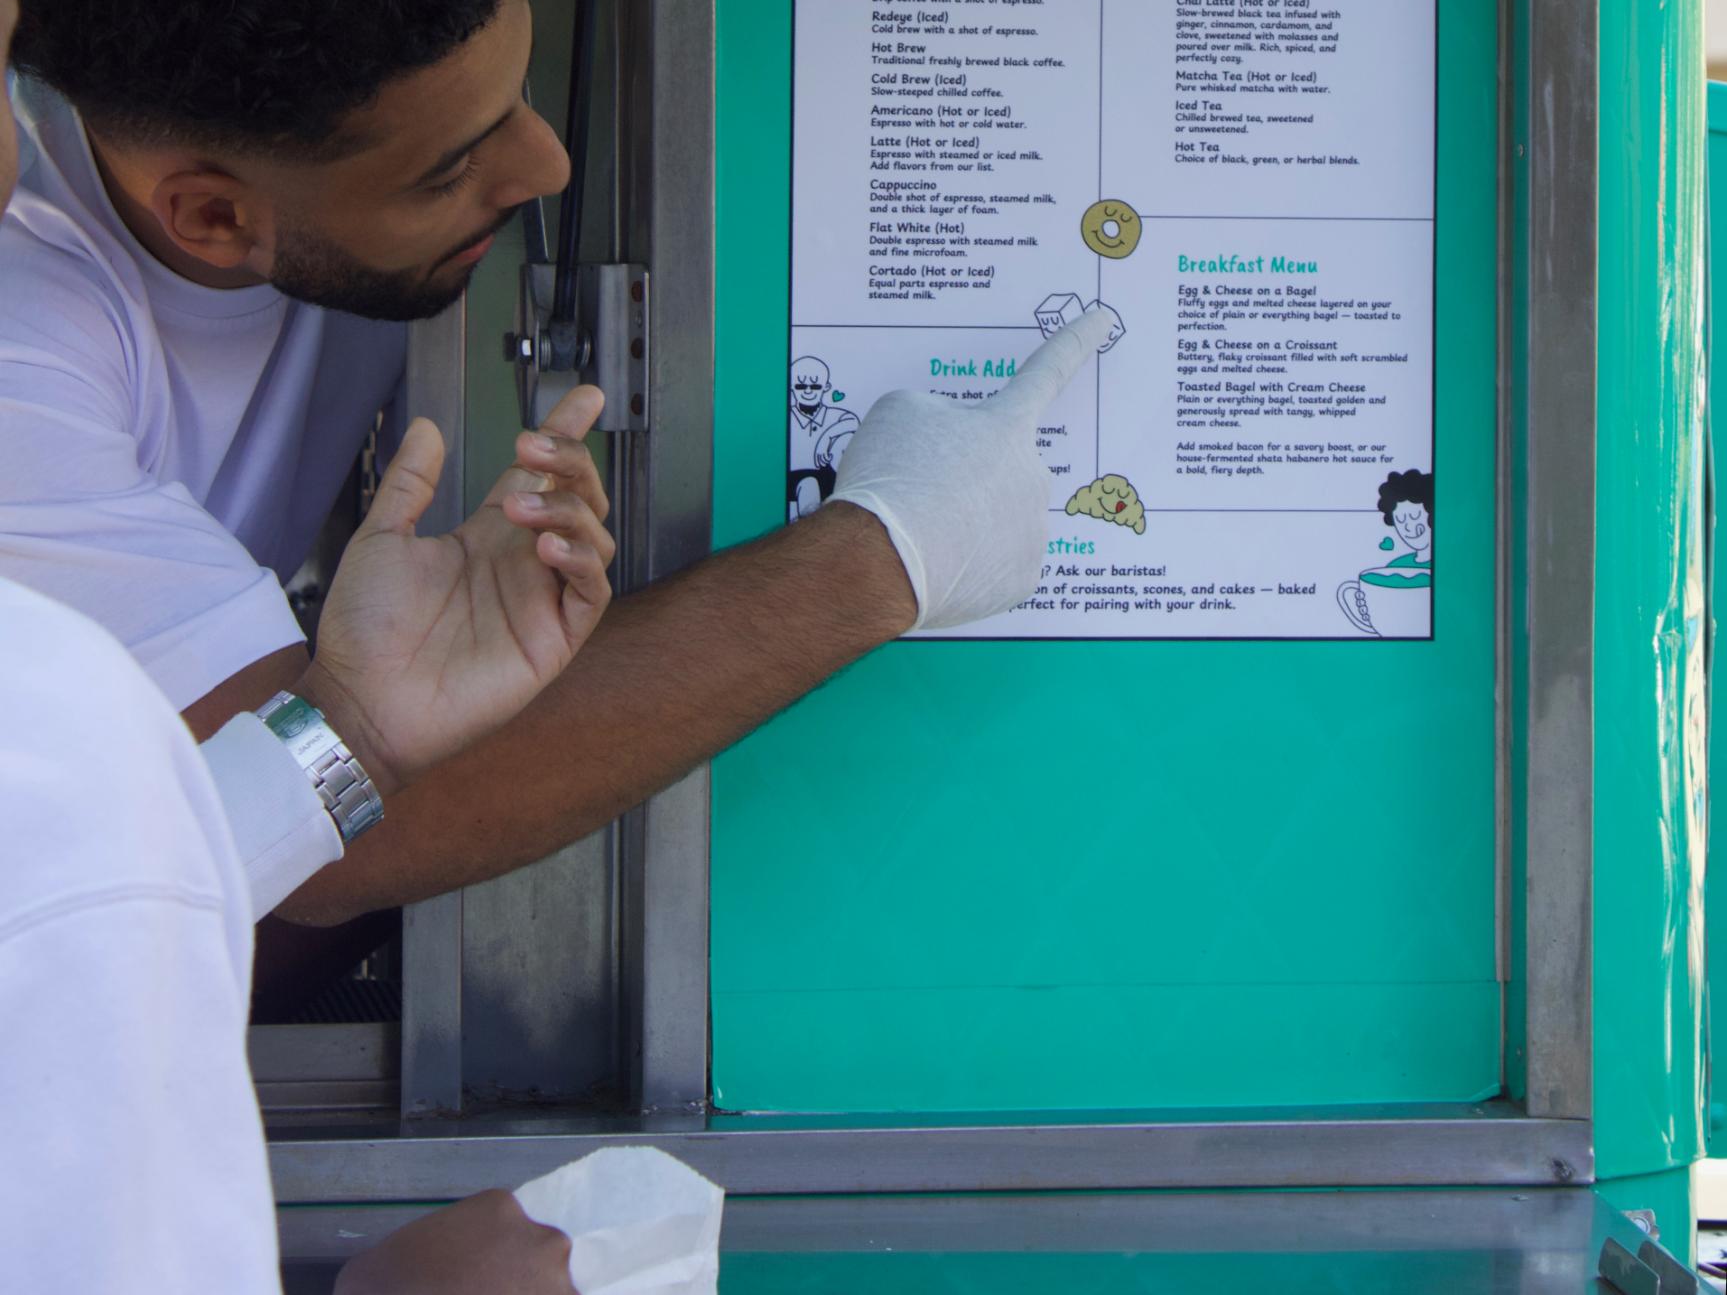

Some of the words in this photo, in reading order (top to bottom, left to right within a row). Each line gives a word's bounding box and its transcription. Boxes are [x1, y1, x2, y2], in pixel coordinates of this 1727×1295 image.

[872, 11, 912, 25] Redeye
[916, 11, 949, 24] (Iced)
[871, 42, 892, 52] Hot
[897, 42, 926, 53] Brew
[871, 55, 925, 64] Traditional
[928, 56, 962, 68] freshly
[965, 57, 1000, 66] brewed
[1003, 58, 1029, 66] black
[1032, 58, 1065, 67] coffee.
[871, 73, 897, 84] Cold
[901, 74, 931, 84] Brew
[934, 74, 967, 87] (Iced)
[1175, 70, 1218, 80] Matcha
[1222, 70, 1242, 81] Tea
[1246, 71, 1271, 83] (Hot
[1291, 71, 1317, 84] Iced)
[871, 87, 934, 99] Slow-steeped
[937, 88, 968, 96] chilled
[971, 88, 1003, 97] coffee.
[1175, 82, 1196, 91] Pure
[1200, 83, 1237, 92] whisked
[1239, 84, 1275, 92] matcha
[1278, 84, 1298, 93] with
[1301, 85, 1330, 93] water.
[870, 104, 933, 115] Americano
[937, 105, 962, 118] (Hot
[984, 106, 1011, 119] Iced)
[1175, 100, 1198, 110] Iced
[1201, 100, 1222, 110] Tea
[870, 136, 901, 146] Latte
[905, 136, 931, 149] (Hot
[935, 139, 948, 147] or
[952, 137, 980, 150] Iced)
[1175, 140, 1195, 151] Hot
[1199, 141, 1220, 152] Tea
[870, 161, 889, 169] Add
[893, 161, 926, 170] flavors
[930, 162, 954, 170] from
[977, 163, 994, 171] list.
[870, 179, 937, 193] Cappuccino
[869, 221, 892, 232] Flat
[897, 222, 931, 232] White
[935, 223, 964, 235] (Hot)
[869, 247, 888, 256] and
[891, 248, 909, 256] fine
[913, 248, 967, 256] microfoam.
[1178, 255, 1264, 273] Breakfast
[1270, 255, 1318, 273] Menu
[869, 265, 917, 276] Cortado
[921, 266, 946, 278] (Hot
[967, 266, 995, 279] Iced)
[1178, 284, 1198, 298] Egg
[1202, 285, 1211, 295] &
[1215, 285, 1253, 295] Cheese
[1286, 285, 1316, 299] Bagel
[1177, 322, 1227, 333] perfection.
[1177, 339, 1198, 352] Egg
[1201, 339, 1211, 349] &
[1214, 339, 1252, 349] Cheese
[1285, 340, 1337, 350] Croissant
[930, 358, 977, 377] Drink
[1177, 381, 1221, 391] Toasted
[1225, 381, 1255, 395] Bagel
[1259, 381, 1283, 392] with
[1287, 382, 1324, 392] Cream
[1328, 382, 1366, 392] Cheese
[961, 390, 983, 400] shot
[1177, 407, 1226, 418] generously
[1229, 407, 1260, 418] spread
[1263, 407, 1283, 415] with
[1286, 407, 1315, 418] tangy,
[1318, 407, 1356, 419] whipped
[1209, 418, 1240, 427] cheese.
[1036, 425, 1068, 436] ramel,
[1047, 536, 1095, 555] stries
[1055, 565, 1080, 576] Ask
[1084, 568, 1106, 576] our
[1111, 565, 1166, 576] baristas!
[1053, 583, 1068, 594] of
[1071, 583, 1138, 596] croissants,
[1143, 586, 1186, 596] scones,
[1191, 583, 1215, 594] and
[1219, 583, 1255, 594] cakes
[1278, 583, 1316, 595] baked
[1009, 597, 1055, 613] erfect
[1060, 598, 1080, 609] for
[1084, 598, 1130, 614] pairing
[1134, 598, 1162, 609] with
[1166, 601, 1195, 614] your
[1199, 598, 1236, 609] drink.
